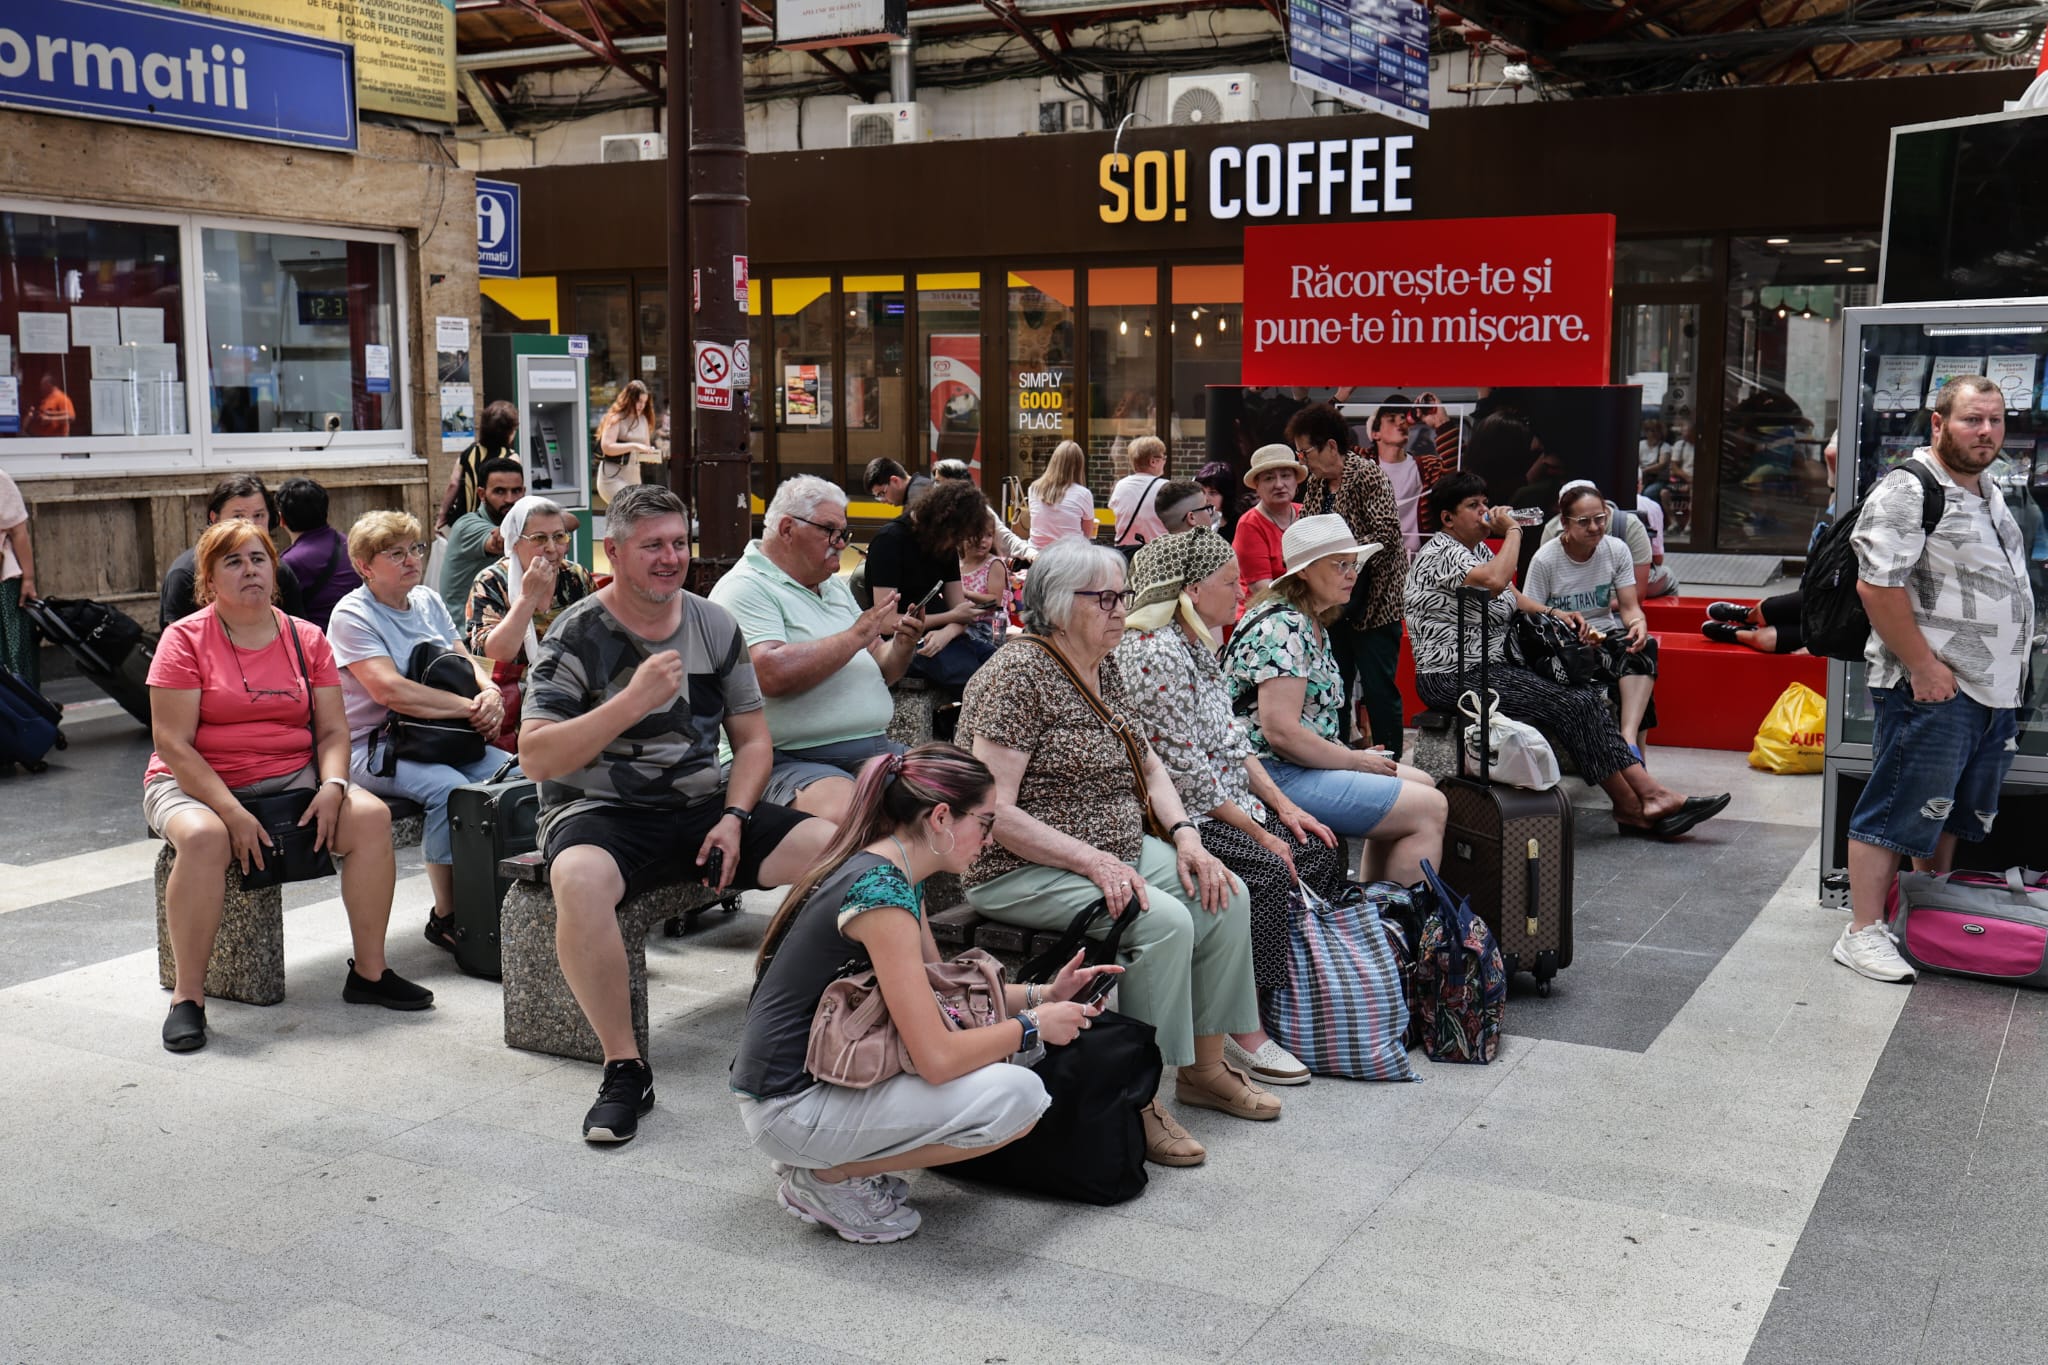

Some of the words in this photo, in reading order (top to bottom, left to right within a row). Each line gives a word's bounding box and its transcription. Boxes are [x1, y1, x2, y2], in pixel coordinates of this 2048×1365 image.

[321, 0, 376, 20] REABILITARE
[388, 13, 444, 33] MODERNIZARE
[345, 30, 382, 43] Coridorul
[384, 37, 436, 54] Pan-European
[378, 23, 409, 38] FERATE
[1099, 149, 1188, 224] SO!
[1209, 135, 1414, 220] COFFEE
[1290, 262, 1515, 304] Răcorește-te
[1522, 258, 1553, 303] și
[1254, 312, 1384, 353] pune-te
[1391, 309, 1424, 344] în
[1431, 308, 1591, 351] mișcare.
[1019, 372, 1063, 388] SIMPLY
[1019, 391, 1063, 409] GOOD
[1019, 412, 1063, 430] PLACE
